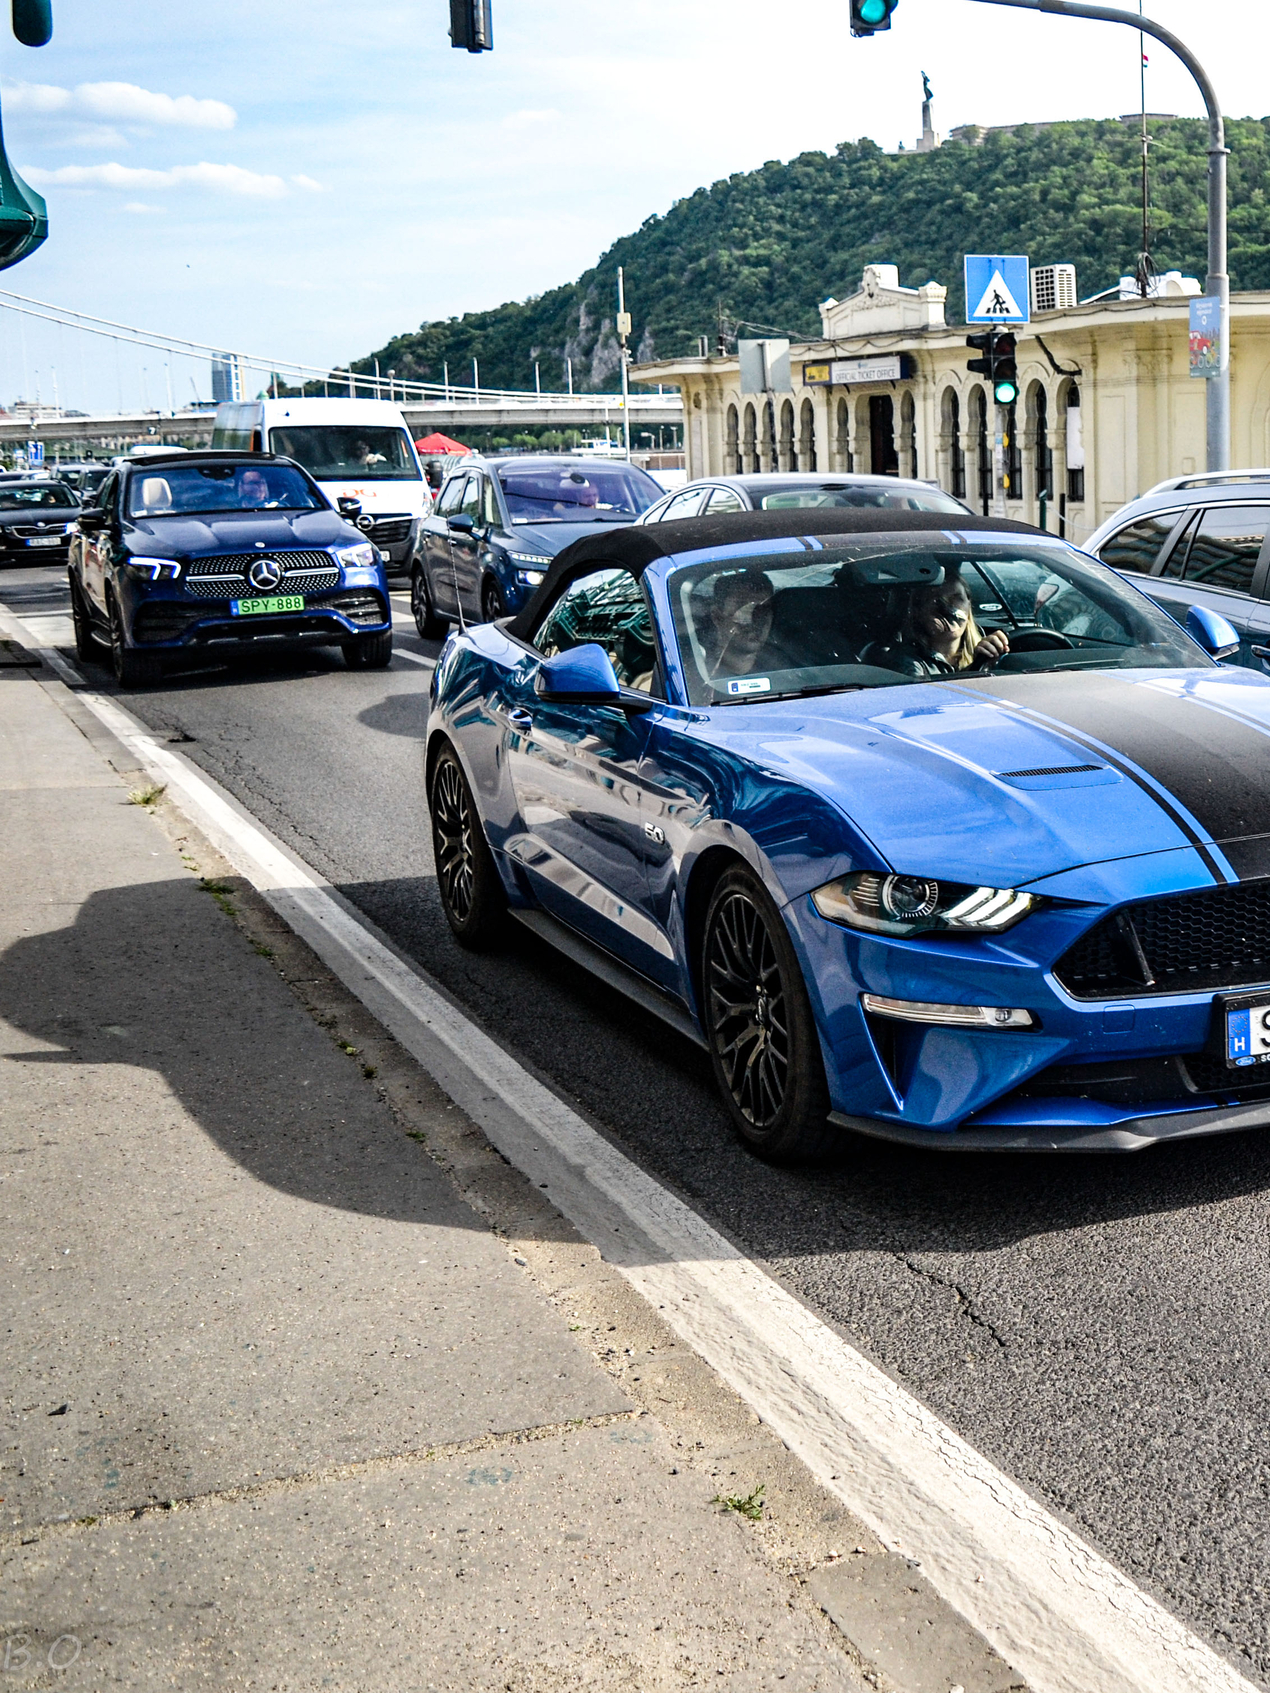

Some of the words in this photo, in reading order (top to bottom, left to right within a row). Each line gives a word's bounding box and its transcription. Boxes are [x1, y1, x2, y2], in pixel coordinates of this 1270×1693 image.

[836, 371, 857, 382] OFFICIAL
[858, 370, 876, 380] TICKET
[876, 368, 896, 379] OFFICE
[241, 597, 302, 613] SPY-888
[1233, 1036, 1246, 1052] H
